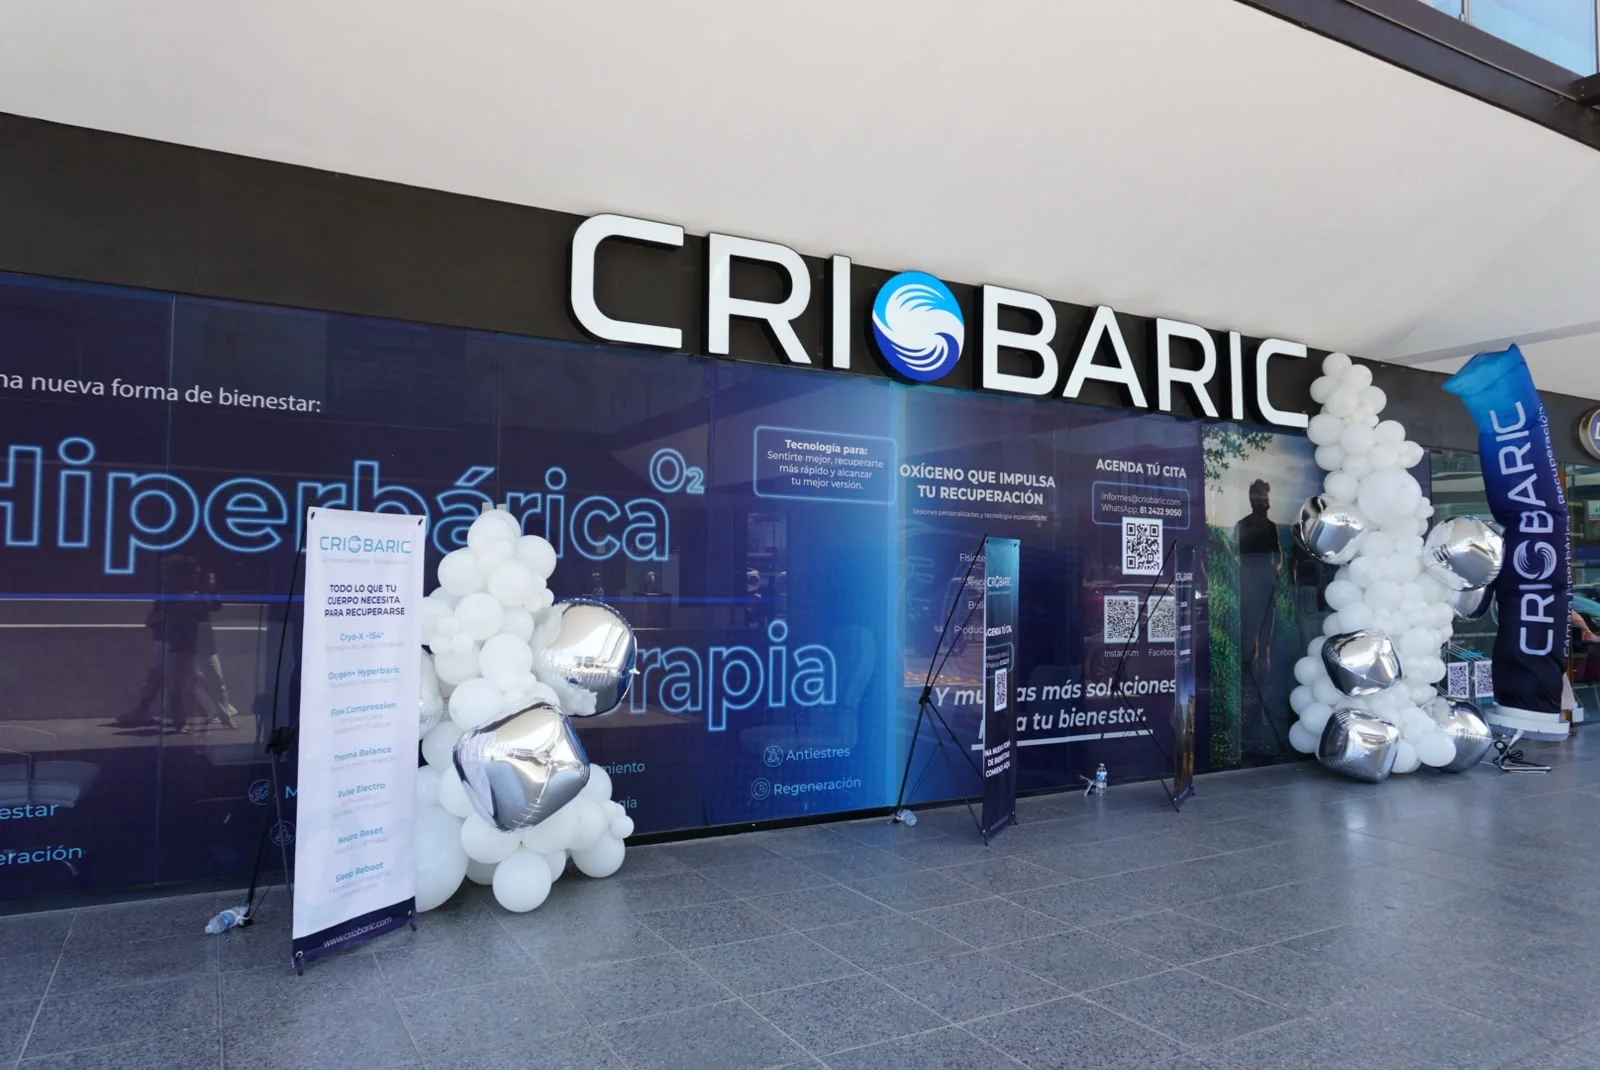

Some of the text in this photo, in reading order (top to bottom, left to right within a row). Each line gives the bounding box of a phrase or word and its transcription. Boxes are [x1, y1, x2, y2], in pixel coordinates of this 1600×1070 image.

[0, 374, 321, 413] na nueva forma de bienestar:
[785, 439, 868, 456] Tecnología para:
[767, 450, 884, 469] Sentirte mejor, recuperarte
[779, 463, 872, 479] más rápido y alcanzar
[899, 463, 1056, 489] OXÍGENO QUE IMPULSA
[1096, 458, 1187, 479] AGENDA TÚ CITA
[791, 476, 863, 490] tu mejor versión.
[917, 485, 1044, 505] TU RECUPERACIÓN
[1139, 506, 1148, 514] 81
[1148, 507, 1165, 516] 2422
[1165, 508, 1182, 517] 9050
[330, 584, 397, 594] TODO LO QUE TU
[328, 595, 400, 605] CUERPO NECESITA
[325, 607, 405, 618] PARA RECUPERARSE
[357, 665, 400, 679] Hyperbaric
[935, 687, 950, 707] Y
[1042, 679, 1082, 701] más
[346, 701, 396, 716] Compression
[1033, 712, 1052, 731] tu
[359, 746, 392, 758] Balance
[786, 745, 851, 762] Antiestres
[357, 782, 386, 795] Electro
[773, 777, 862, 797] Regeneración
[0, 803, 59, 820] estar
[360, 826, 384, 839] Reset
[0, 845, 83, 866] eración
[335, 869, 354, 883] Sleep
[355, 861, 384, 876] Reboot
